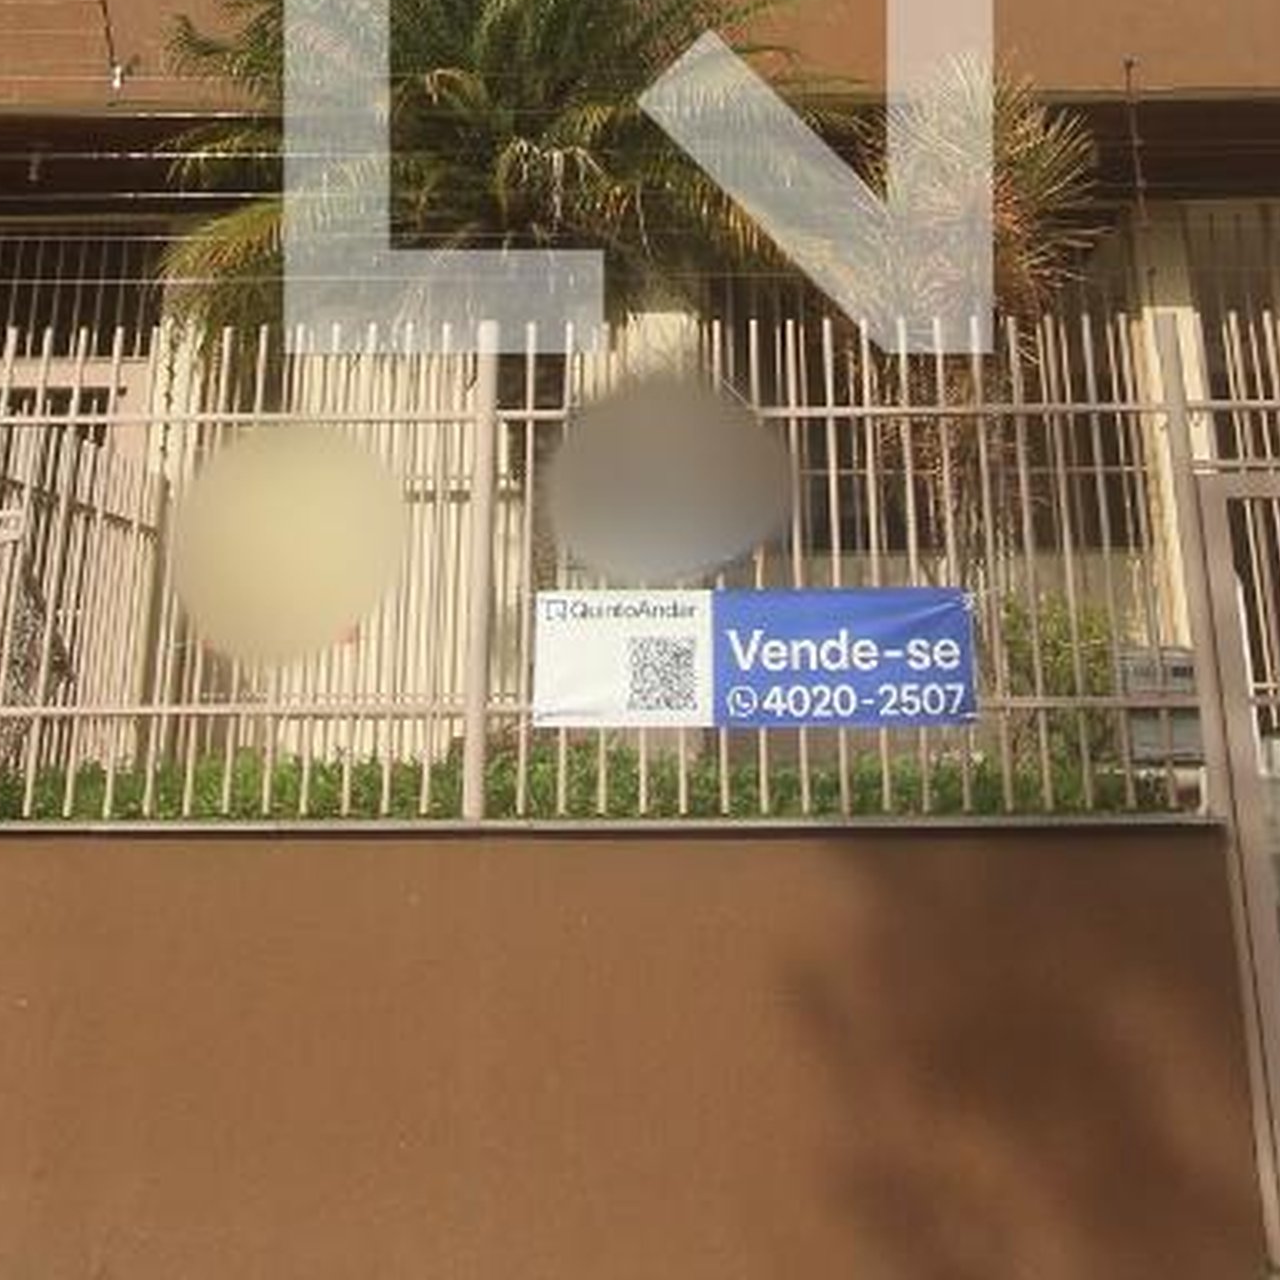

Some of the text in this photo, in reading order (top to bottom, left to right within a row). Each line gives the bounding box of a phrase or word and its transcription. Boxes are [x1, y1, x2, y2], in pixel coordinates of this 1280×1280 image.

[570, 600, 696, 619] QuintoAndar
[728, 629, 961, 671] Vende-se
[763, 683, 964, 718] 4020-2507
